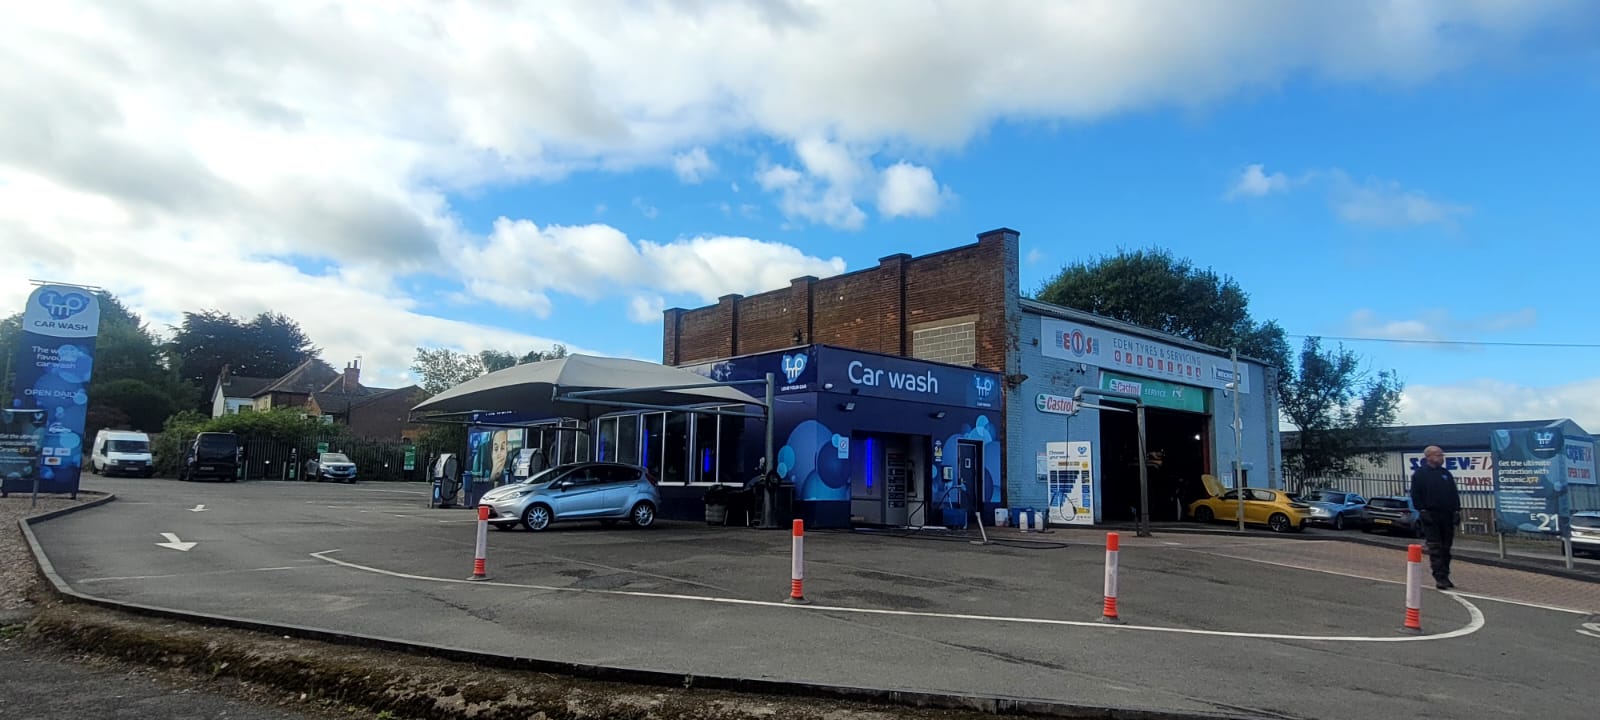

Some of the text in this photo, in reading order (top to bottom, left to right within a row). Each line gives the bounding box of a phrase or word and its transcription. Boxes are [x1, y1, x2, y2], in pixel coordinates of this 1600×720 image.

[34, 320, 88, 332] CAR WASH
[32, 345, 49, 353] The
[1113, 337, 1201, 366] EDEN TYRES & SERVICING
[848, 361, 939, 394] Car wash
[24, 388, 78, 399] OPEN DAILY
[1117, 382, 1140, 396] Castrol
[1046, 397, 1074, 412] Castrol
[1410, 456, 1494, 470] SEWFI
[1498, 468, 1532, 476] protection
[1464, 476, 1492, 486] DAYS
